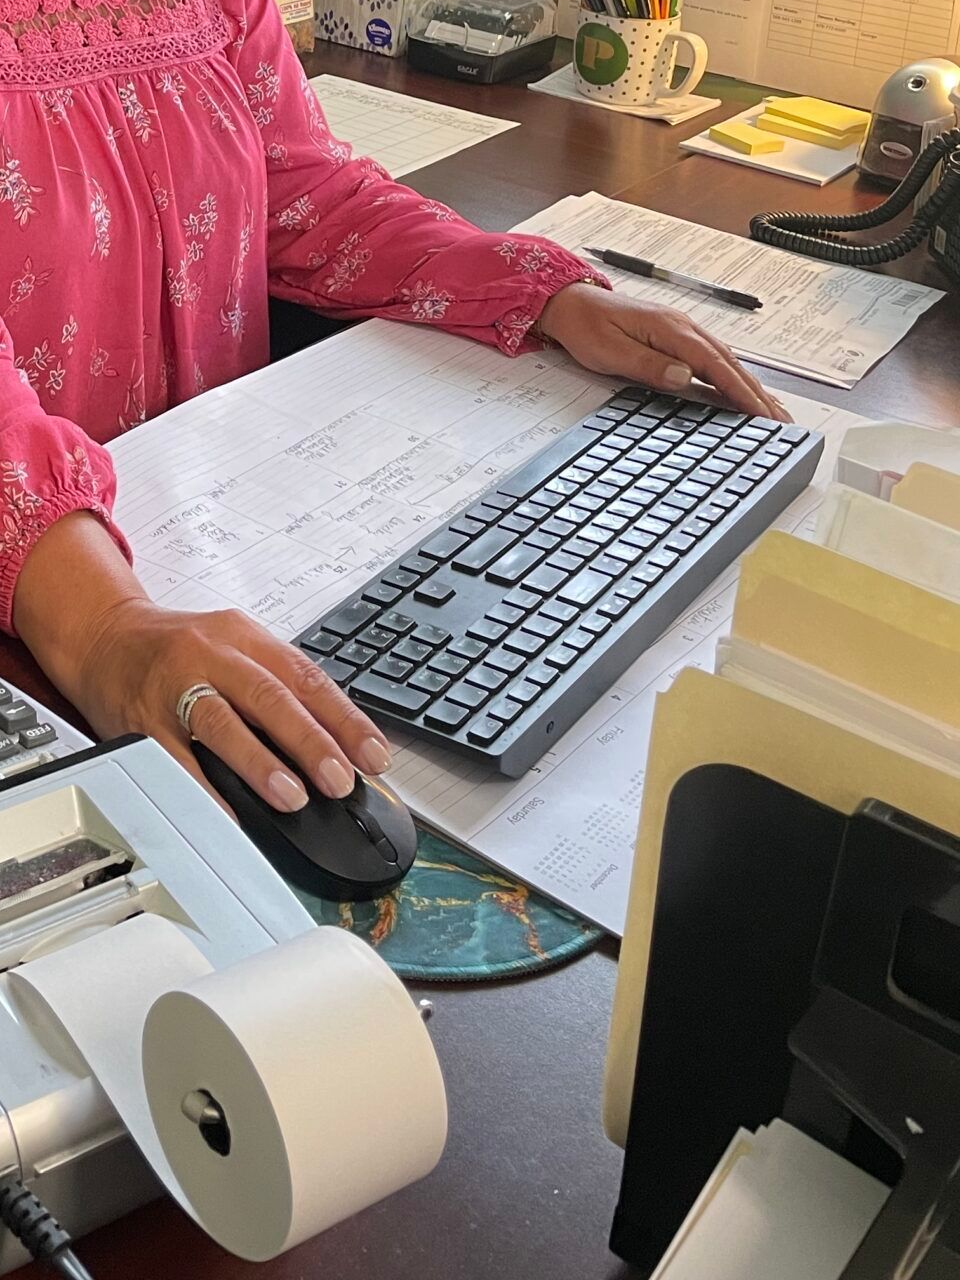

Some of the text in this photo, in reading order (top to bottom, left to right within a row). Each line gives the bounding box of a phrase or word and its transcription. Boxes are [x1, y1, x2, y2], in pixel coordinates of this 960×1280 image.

[583, 36, 614, 71] P
[333, 565, 348, 573] 25
[610, 694, 622, 702] 4
[26, 724, 51, 737] FEED
[596, 726, 624, 746] Friday
[506, 796, 545, 826] Saturday
[590, 863, 619, 891] December
